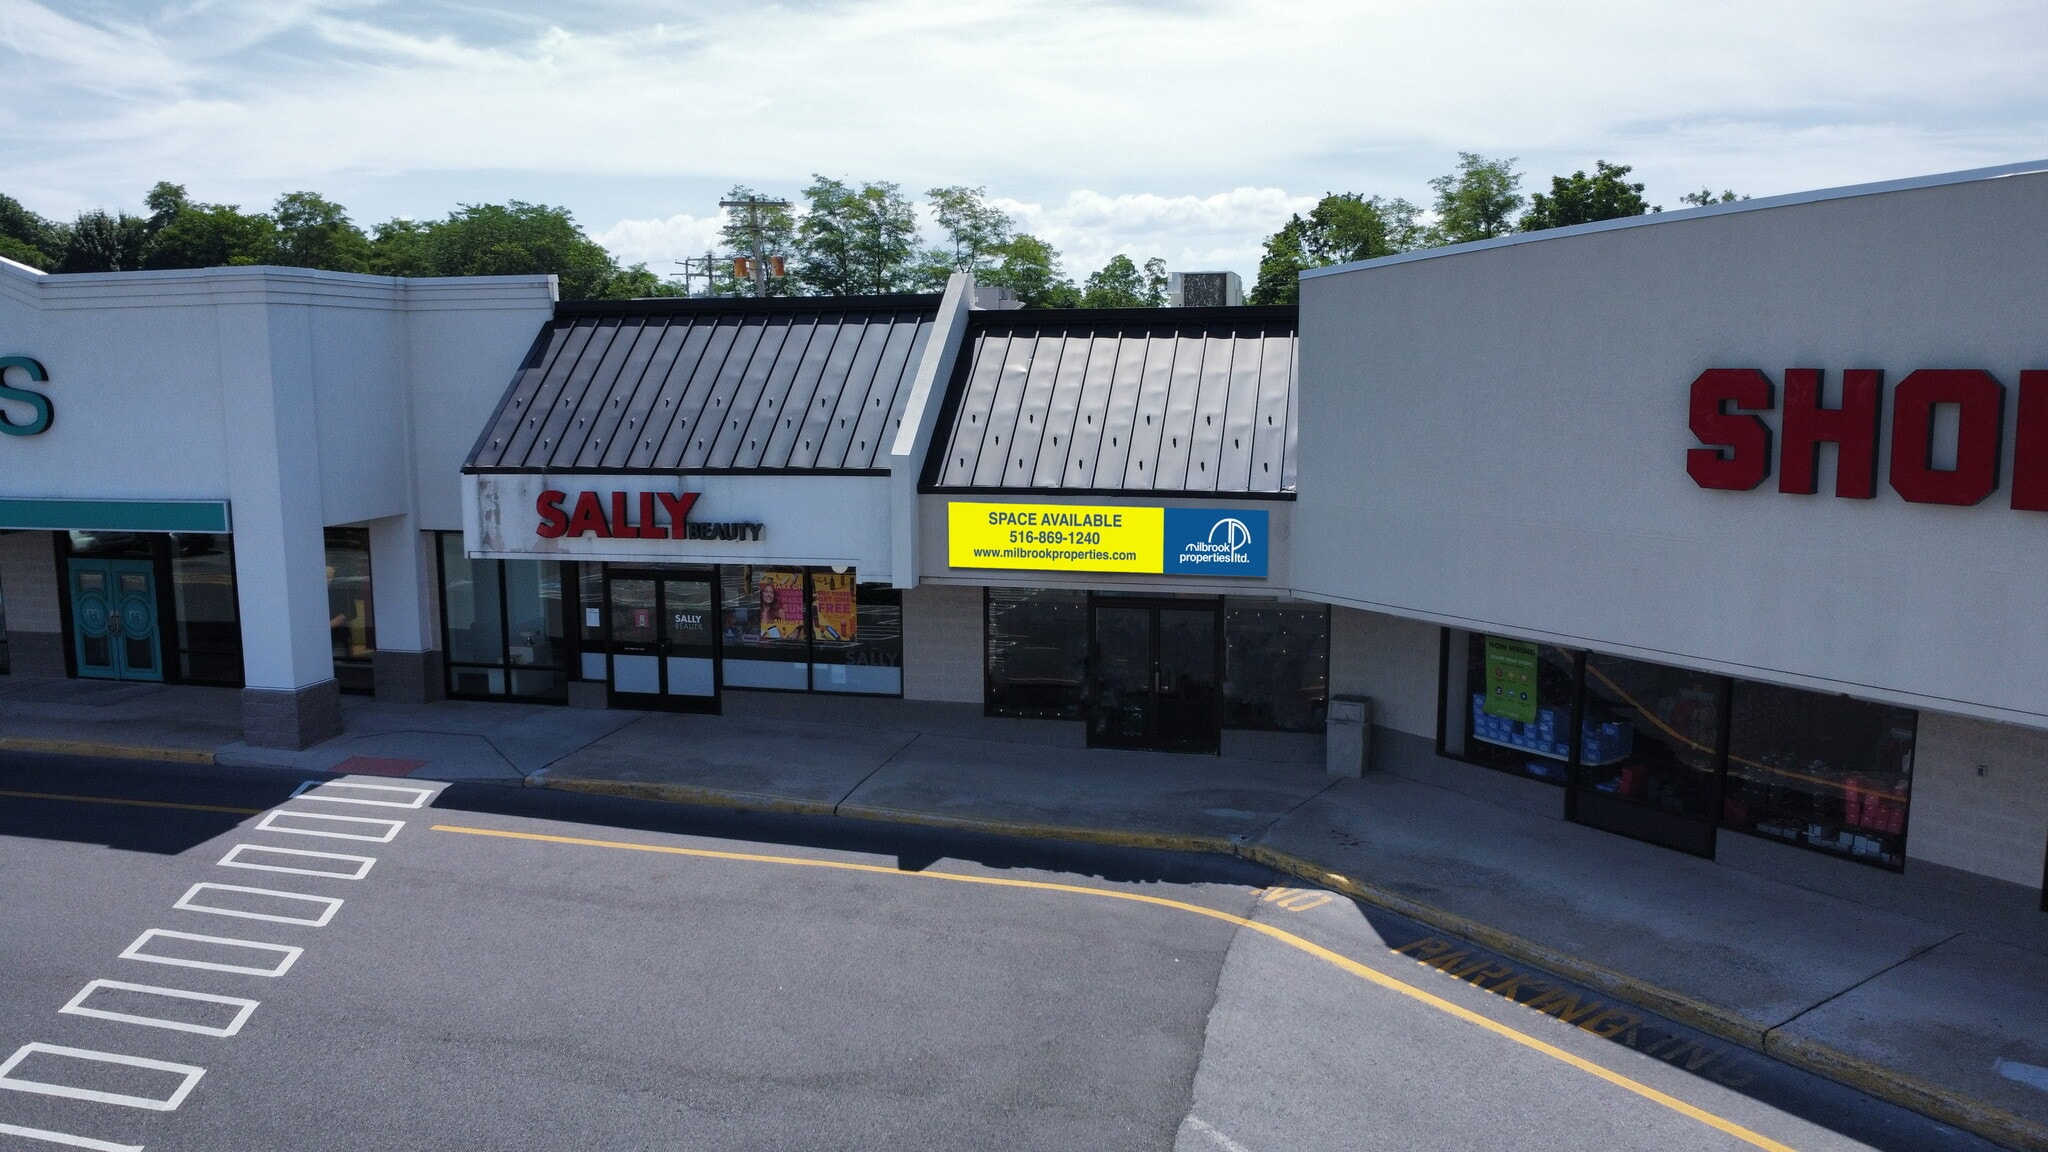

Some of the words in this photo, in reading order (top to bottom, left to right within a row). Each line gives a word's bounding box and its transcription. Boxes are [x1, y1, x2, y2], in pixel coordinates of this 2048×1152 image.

[536, 490, 701, 540] SALLY
[988, 511, 1037, 526] SPACE
[1041, 513, 1122, 528] AVAILABLE
[687, 521, 764, 542] BEAUTY
[1009, 530, 1100, 545] 516-869-1240
[1185, 541, 1230, 552] milbrook
[973, 547, 1137, 562] www.milbrookproperties.com
[1180, 551, 1232, 565] properties
[818, 603, 850, 613] FREE
[675, 614, 702, 623] SALLY
[1488, 642, 1508, 650] NOW
[1509, 645, 1536, 656] HIRING
[845, 650, 899, 667] SALLY
[1249, 881, 1333, 912] NO
[1390, 936, 1640, 1039] PARKING
